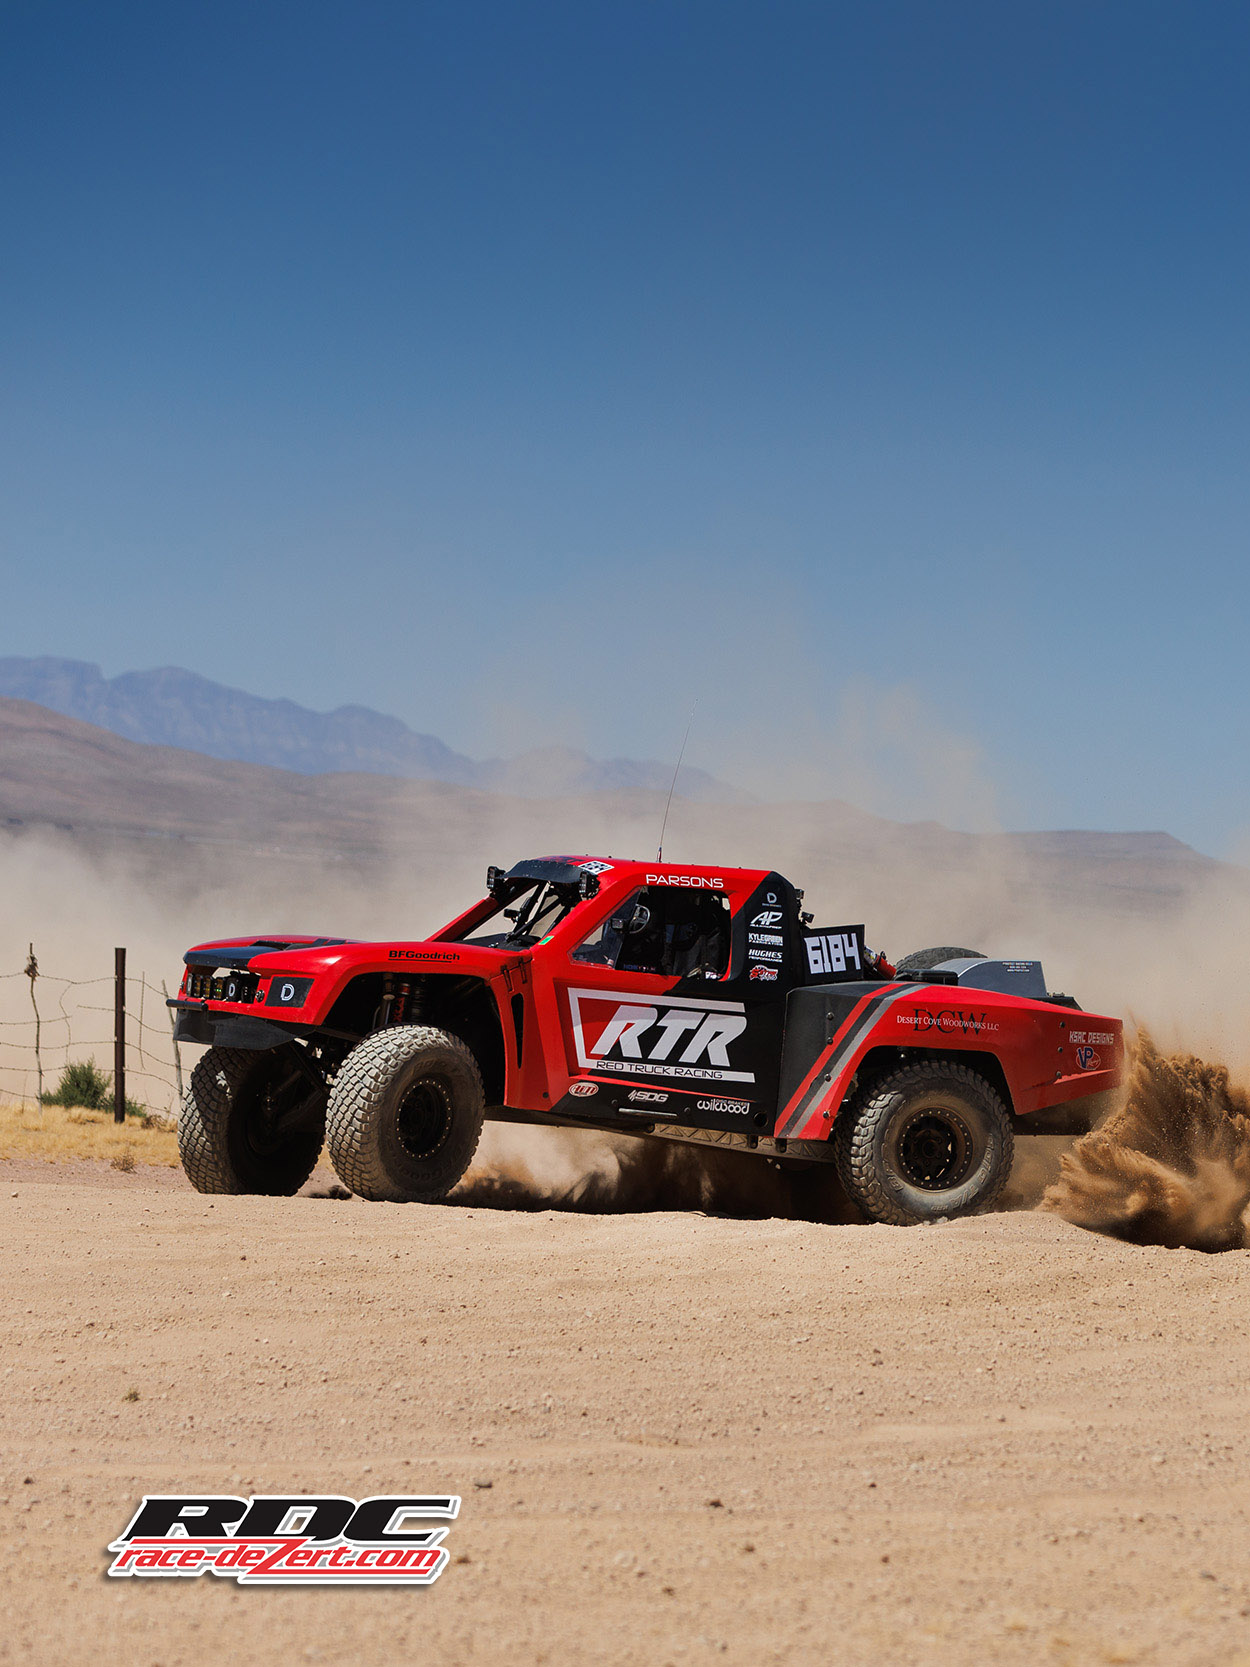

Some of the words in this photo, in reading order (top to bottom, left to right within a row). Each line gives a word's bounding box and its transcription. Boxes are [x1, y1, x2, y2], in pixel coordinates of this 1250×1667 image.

[646, 874, 724, 889] PARSONS
[389, 950, 460, 960] BFGoodrich
[749, 949, 783, 959] HUGHES
[804, 933, 861, 974] 6184
[913, 1008, 987, 1035] DCW
[987, 1023, 999, 1031] LLC
[590, 1005, 747, 1067] RTR
[1088, 1032, 1114, 1045] DESIGNS
[1077, 1046, 1094, 1069] VP
[596, 1060, 624, 1071] RED
[627, 1063, 671, 1075] TRUCK
[674, 1068, 723, 1079] RACING
[697, 1098, 750, 1115] wilwood
